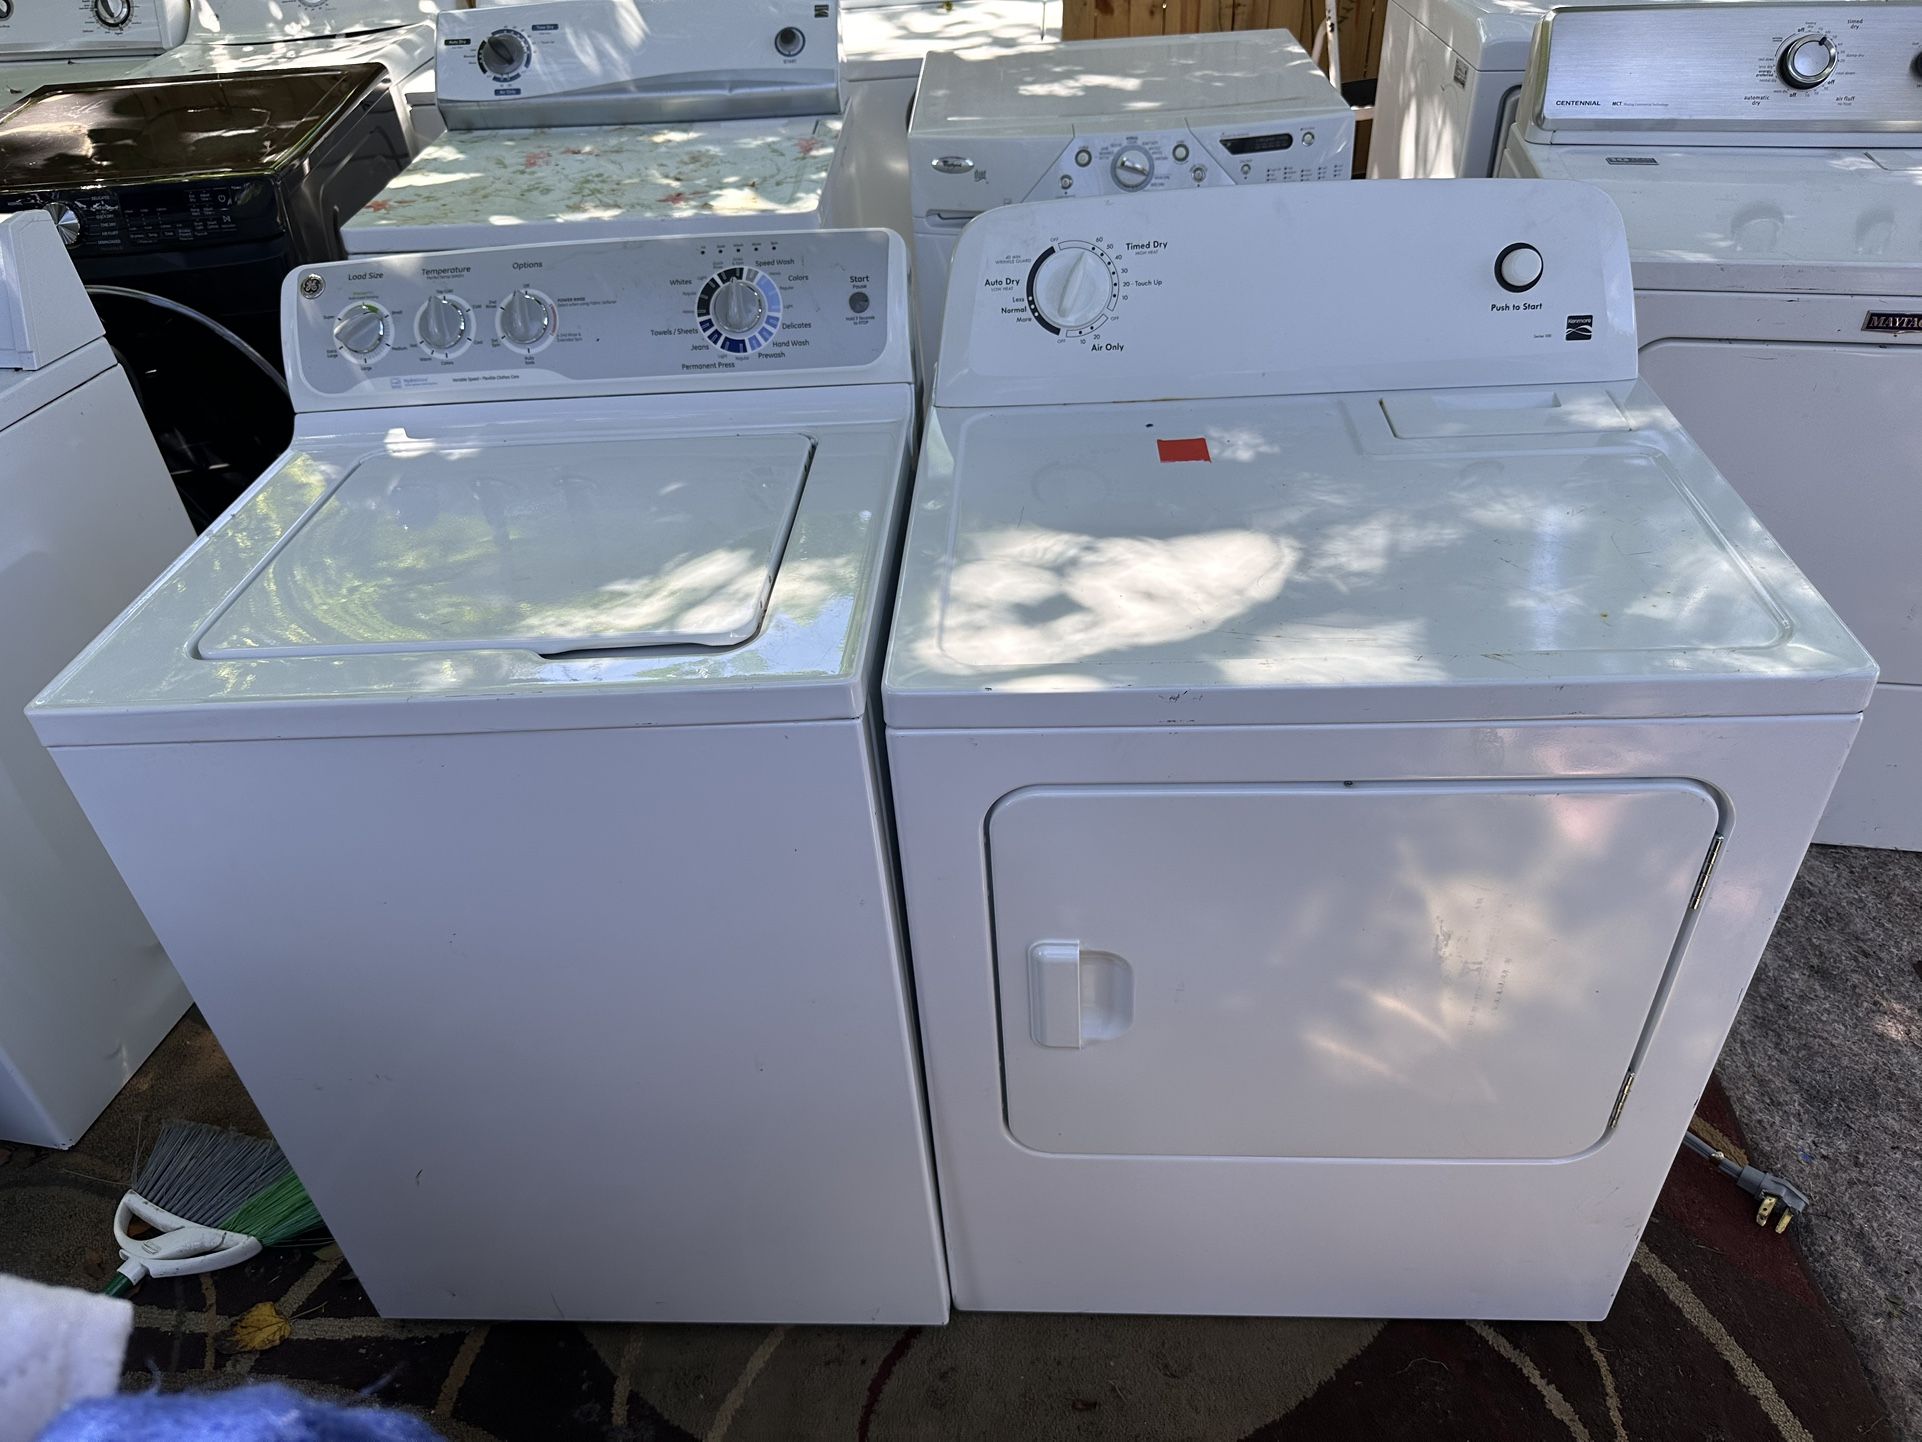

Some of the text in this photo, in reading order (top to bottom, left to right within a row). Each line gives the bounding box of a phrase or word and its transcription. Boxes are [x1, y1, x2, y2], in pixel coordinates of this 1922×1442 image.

[1126, 240, 1168, 251] Timed Dry
[421, 266, 471, 276] Temperature
[512, 262, 543, 271] Options
[669, 278, 692, 286] Whites
[849, 275, 870, 283] Start
[984, 277, 1020, 287] Auto Dry
[1001, 306, 1027, 314] Normal
[1490, 303, 1510, 312] Push
[1522, 302, 1543, 311] Start
[782, 322, 812, 330] Delicates
[690, 344, 710, 352] Jeans
[772, 339, 810, 348] Hand Wash
[1091, 343, 1124, 352] Air Only
[681, 362, 717, 370] Permanent
